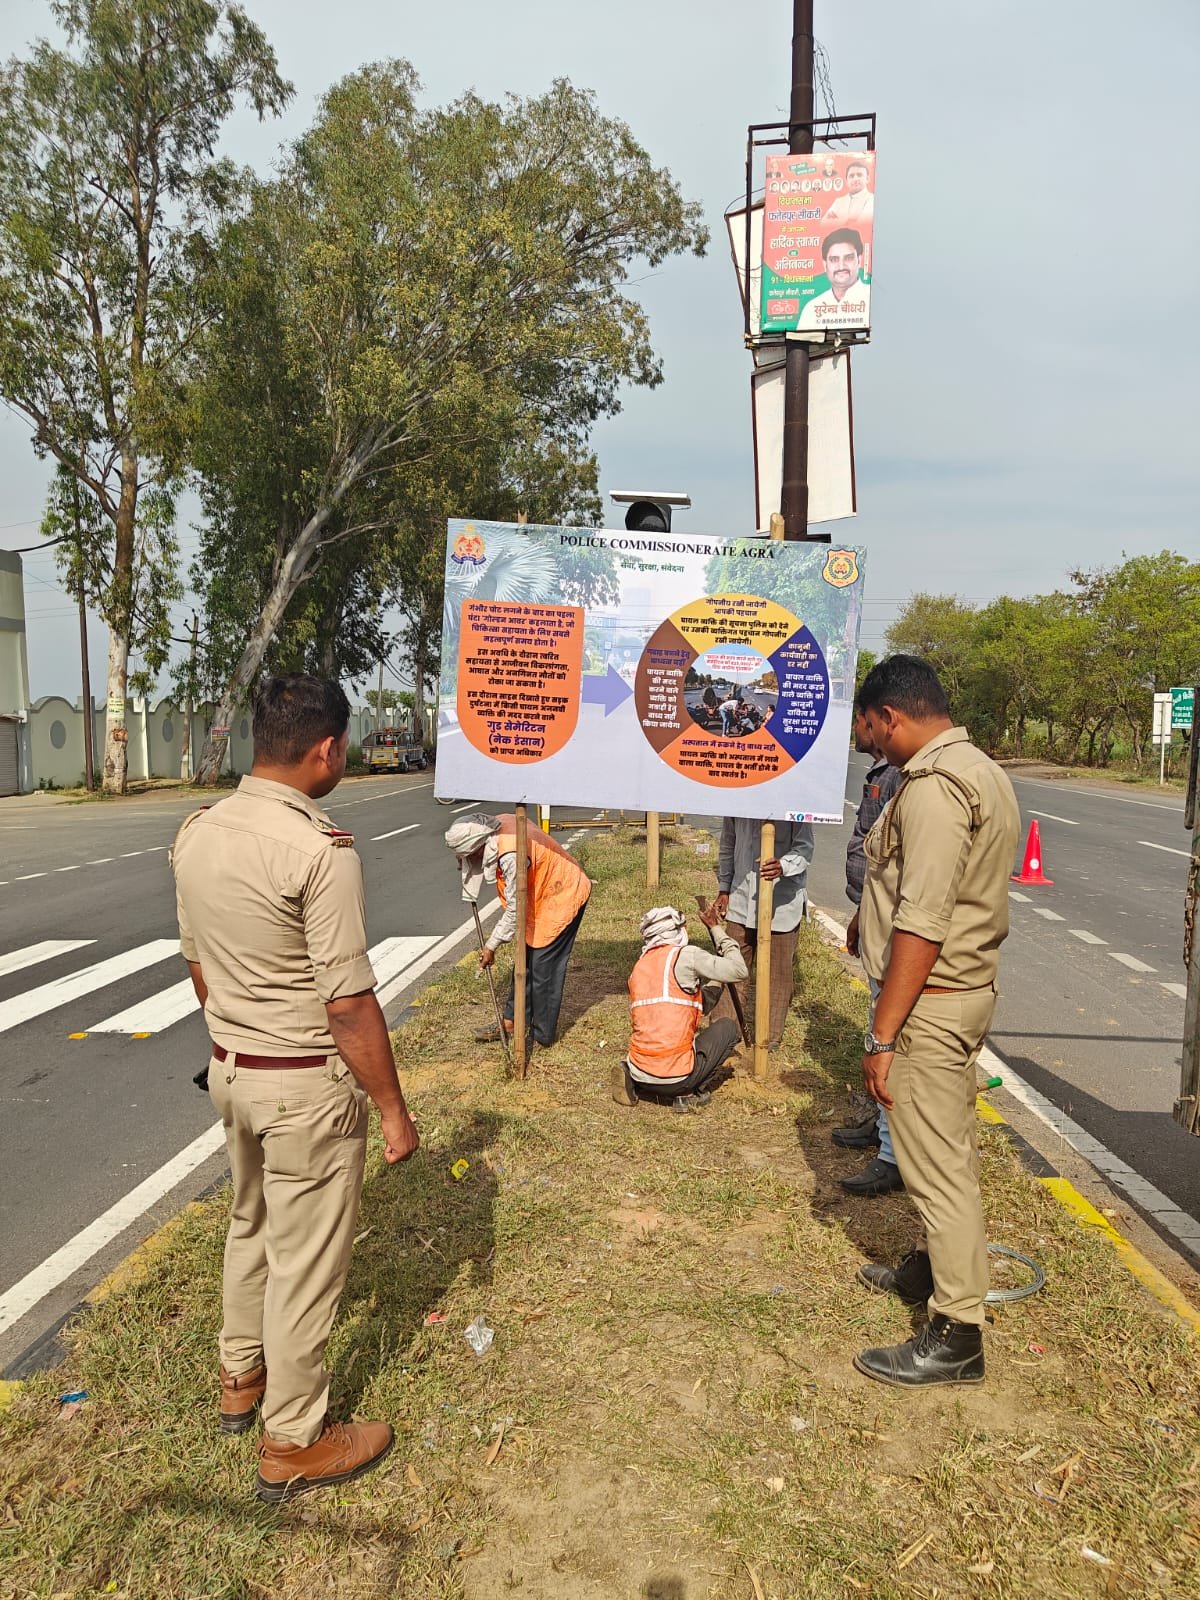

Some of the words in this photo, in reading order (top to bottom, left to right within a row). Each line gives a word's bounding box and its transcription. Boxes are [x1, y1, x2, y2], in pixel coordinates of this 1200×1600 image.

[798, 207, 821, 219] सीकरी
[769, 235, 794, 248] हार्दिक
[796, 237, 820, 248] स्वागत
[560, 535, 607, 548] POLICE
[610, 539, 737, 557] COMMISSIONERATE
[741, 546, 774, 560] AGRA
[469, 604, 487, 612] गंभीर
[487, 721, 502, 732] गुड
[504, 720, 546, 733] सेमेरिटन
[489, 734, 511, 745] (नेक
[514, 735, 545, 749] इंसान)
